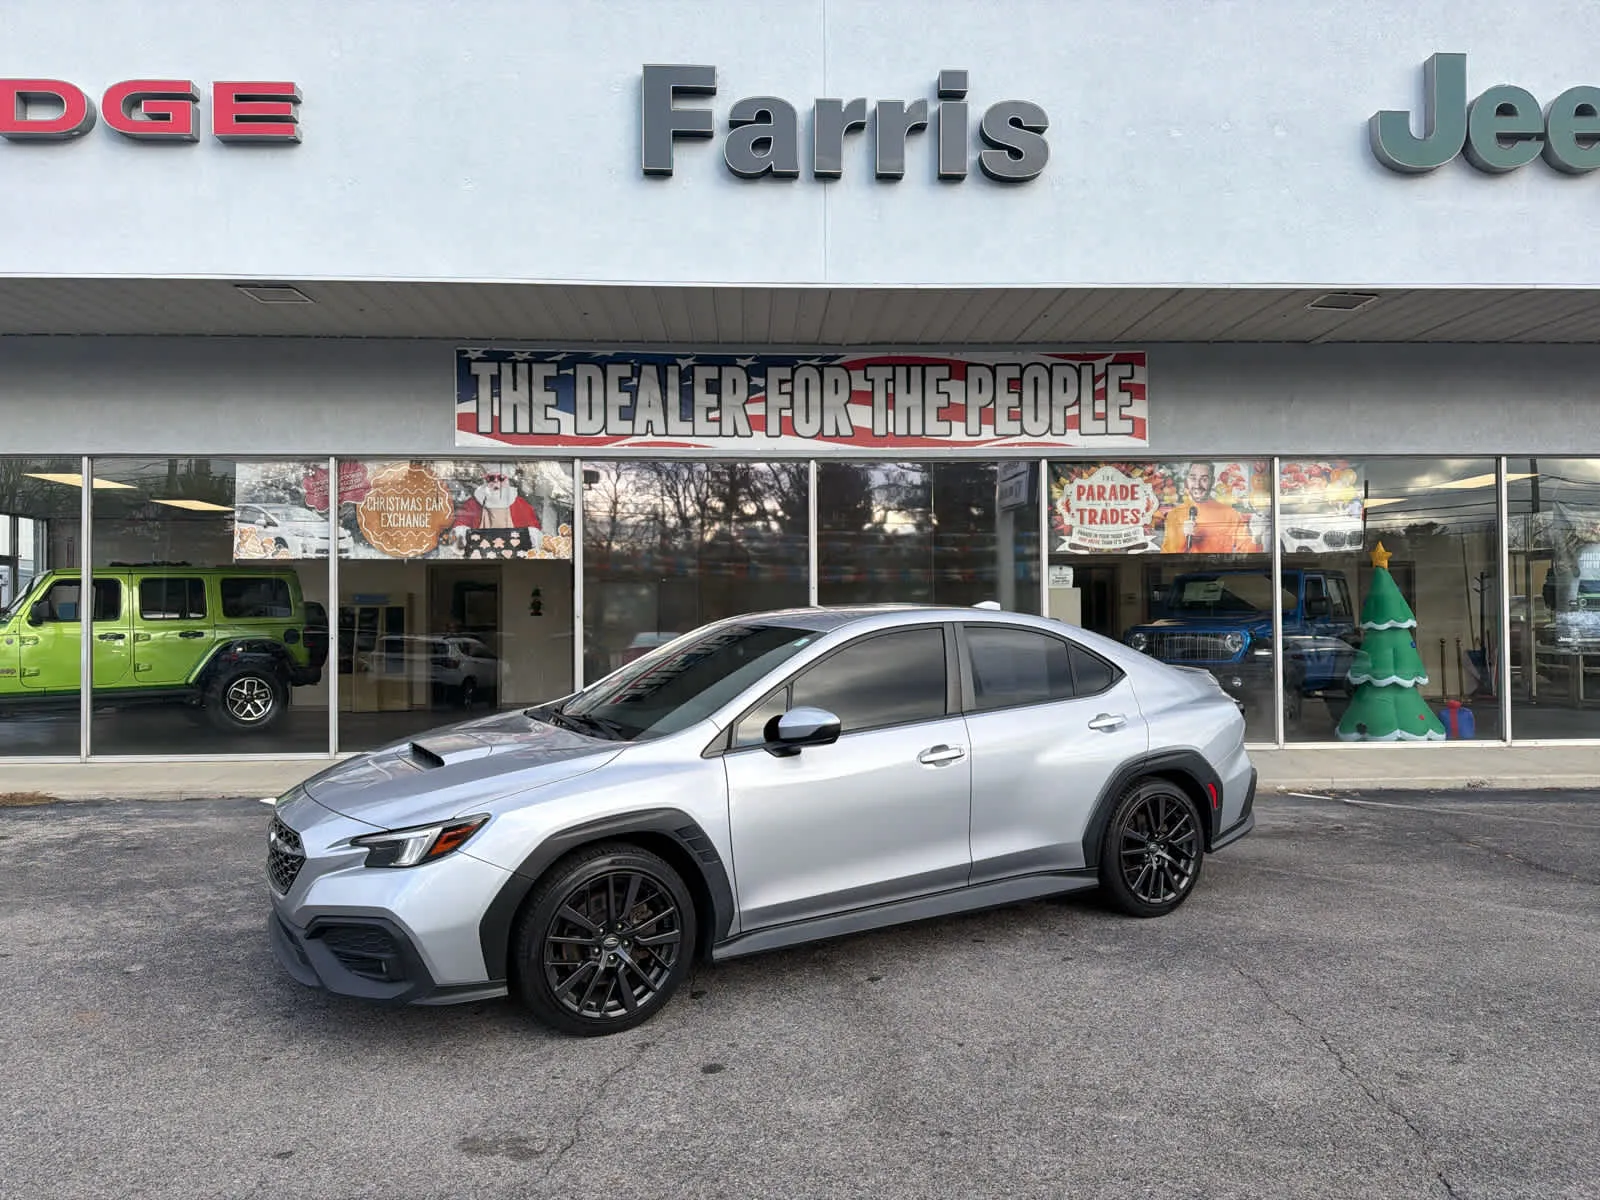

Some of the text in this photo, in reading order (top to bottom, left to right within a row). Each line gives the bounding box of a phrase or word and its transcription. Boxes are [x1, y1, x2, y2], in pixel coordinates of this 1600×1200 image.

[0, 78, 302, 144] DGE
[639, 64, 1050, 182] Farris
[469, 361, 1134, 438] THE DEALER FOR THE PEOPLE
[1076, 484, 1140, 502] PARADE
[366, 496, 445, 512] CHRISTMAS CAR
[381, 512, 432, 528] EXCHANGE
[1076, 508, 1140, 525] TRADES
